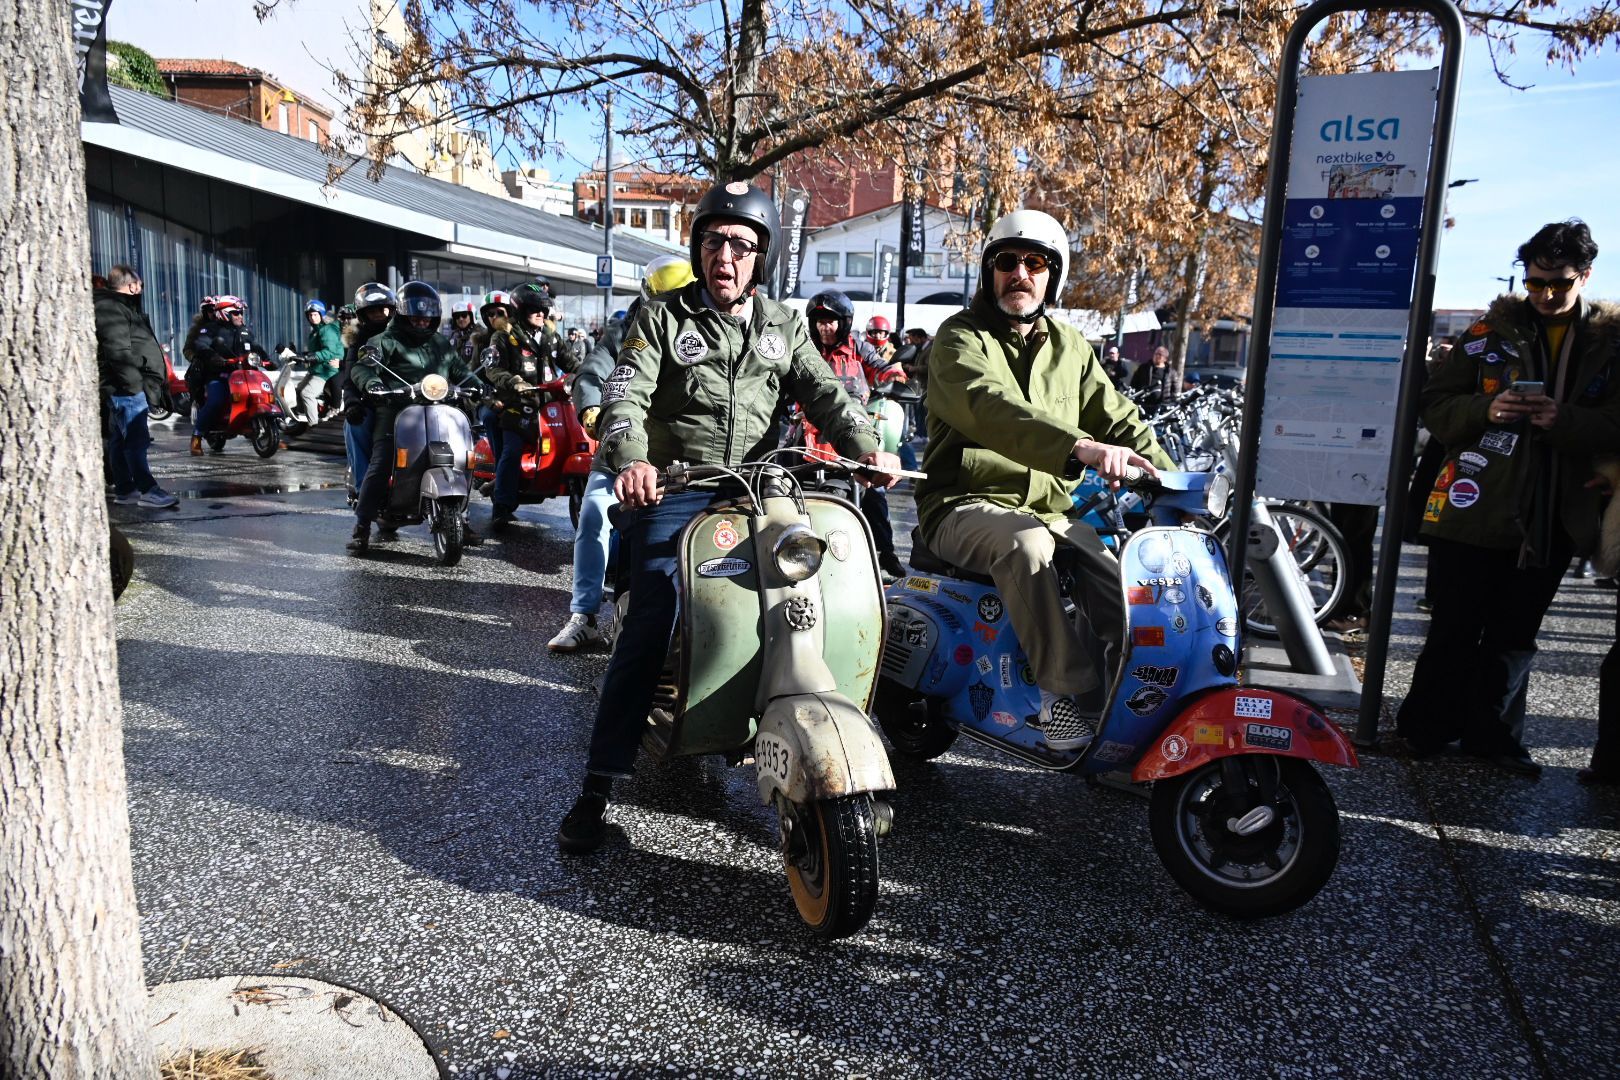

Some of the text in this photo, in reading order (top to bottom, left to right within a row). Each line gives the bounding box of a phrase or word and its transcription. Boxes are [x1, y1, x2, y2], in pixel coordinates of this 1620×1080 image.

[1320, 115, 1400, 142] alsa
[1317, 152, 1374, 164] nextbike
[786, 215, 803, 294] Estrella Galicia
[908, 577, 930, 589] MAVIC
